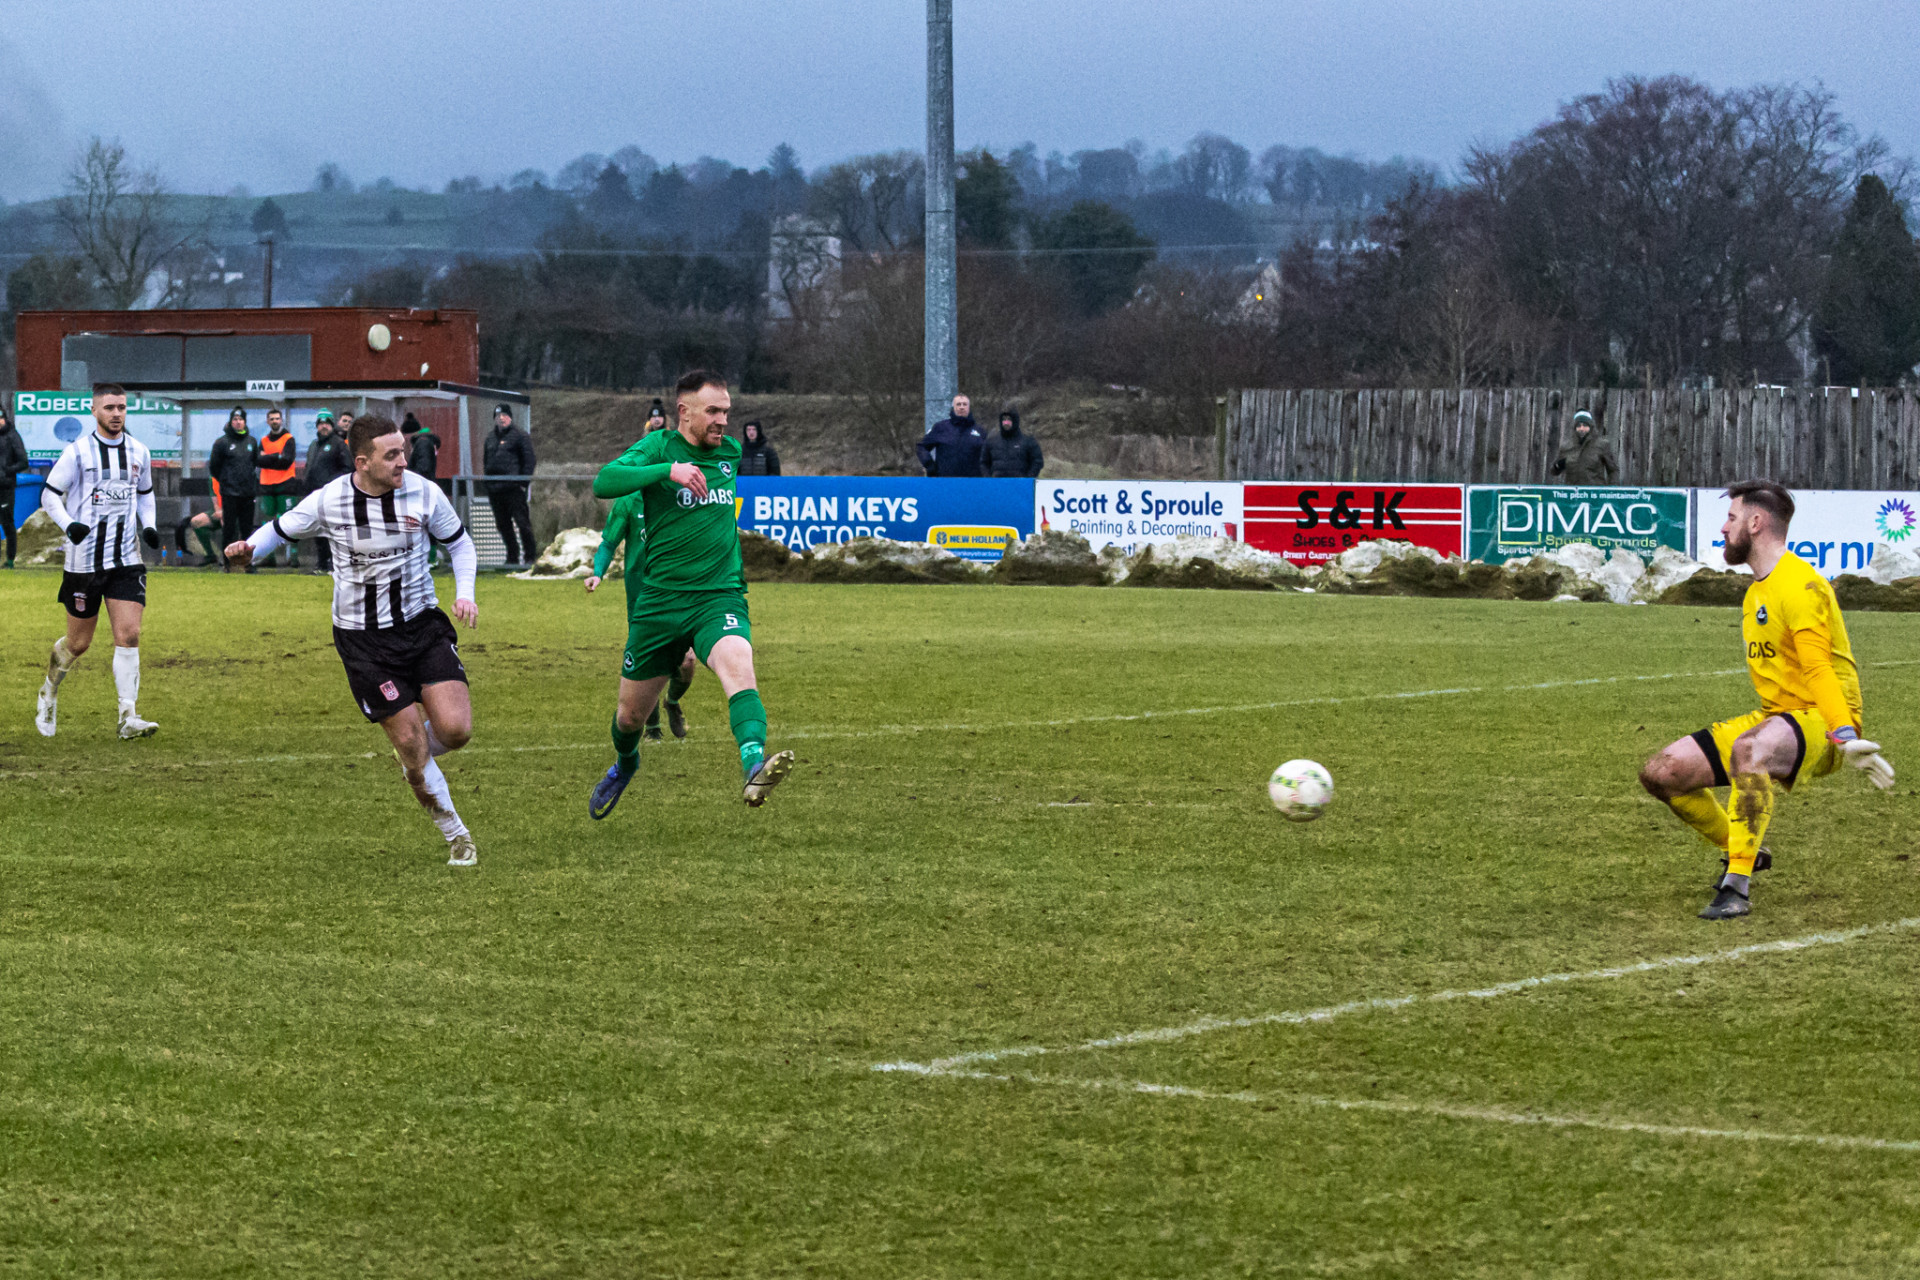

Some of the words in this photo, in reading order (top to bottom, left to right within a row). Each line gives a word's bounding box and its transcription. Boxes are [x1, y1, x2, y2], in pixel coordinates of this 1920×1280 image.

[251, 382, 279, 390] AWAY
[18, 394, 93, 411] ROBER
[1570, 490, 1588, 500] pitch
[1590, 491, 1598, 499] is
[1600, 492, 1639, 500] maintained
[1642, 493, 1651, 501] by
[754, 496, 838, 521] BRIAN
[848, 497, 919, 522] KEYS
[1053, 489, 1108, 514] Scott
[1115, 490, 1133, 515] &
[1141, 490, 1224, 521] Sproule
[1296, 490, 1319, 529] S
[1329, 491, 1363, 530] &
[1373, 491, 1407, 530] K
[1502, 501, 1658, 534] DIMAC
[1071, 519, 1123, 537] Painting
[1127, 520, 1137, 535] &
[1141, 521, 1212, 538] Decorating
[972, 536, 1007, 544] HOLLAN
[1546, 535, 1592, 547] Sports
[1597, 537, 1657, 548] Grounds
[1308, 551, 1334, 560] CASTLE
[725, 613, 738, 626] 5
